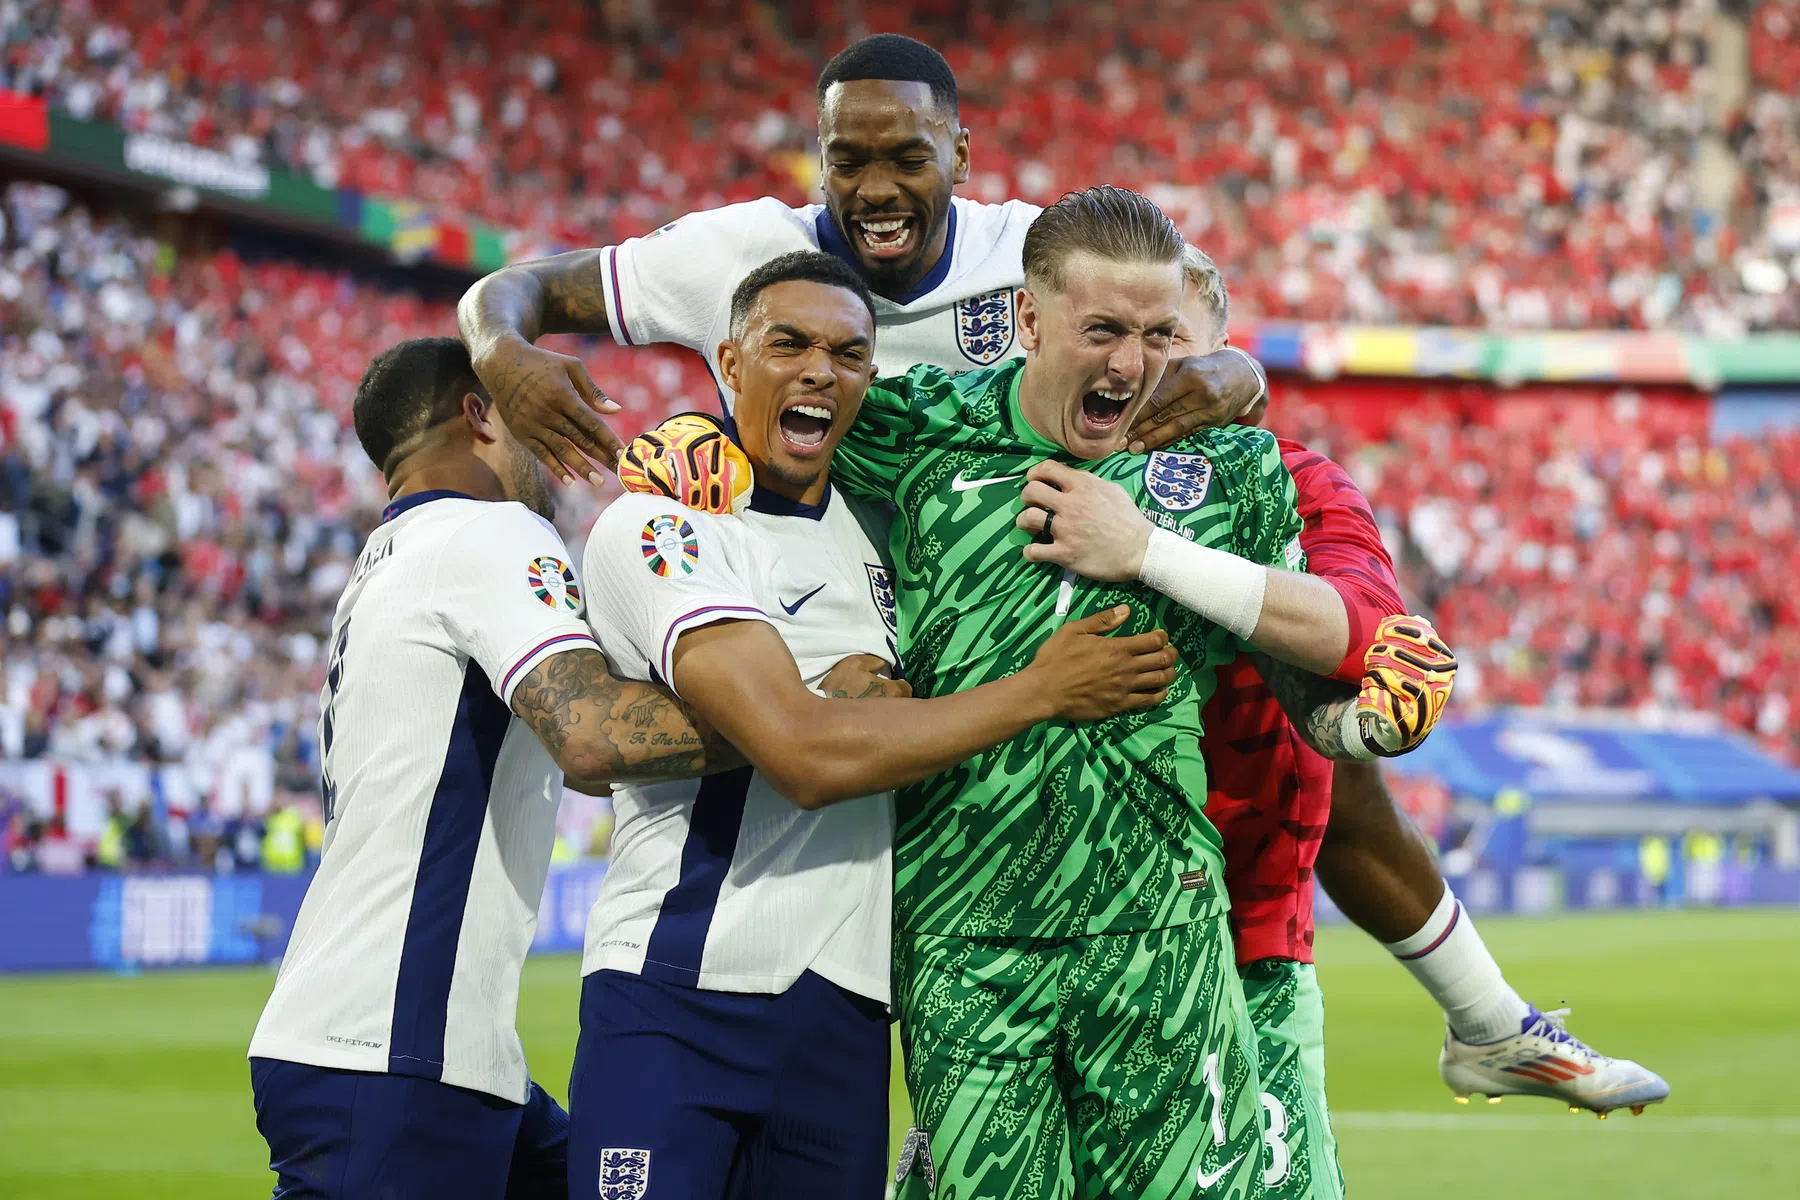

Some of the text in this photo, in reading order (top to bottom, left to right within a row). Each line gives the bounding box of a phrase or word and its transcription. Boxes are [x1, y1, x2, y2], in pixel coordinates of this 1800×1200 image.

[629, 731, 647, 744] To
[650, 732, 673, 746] The
[1202, 1052, 1227, 1148] 1
